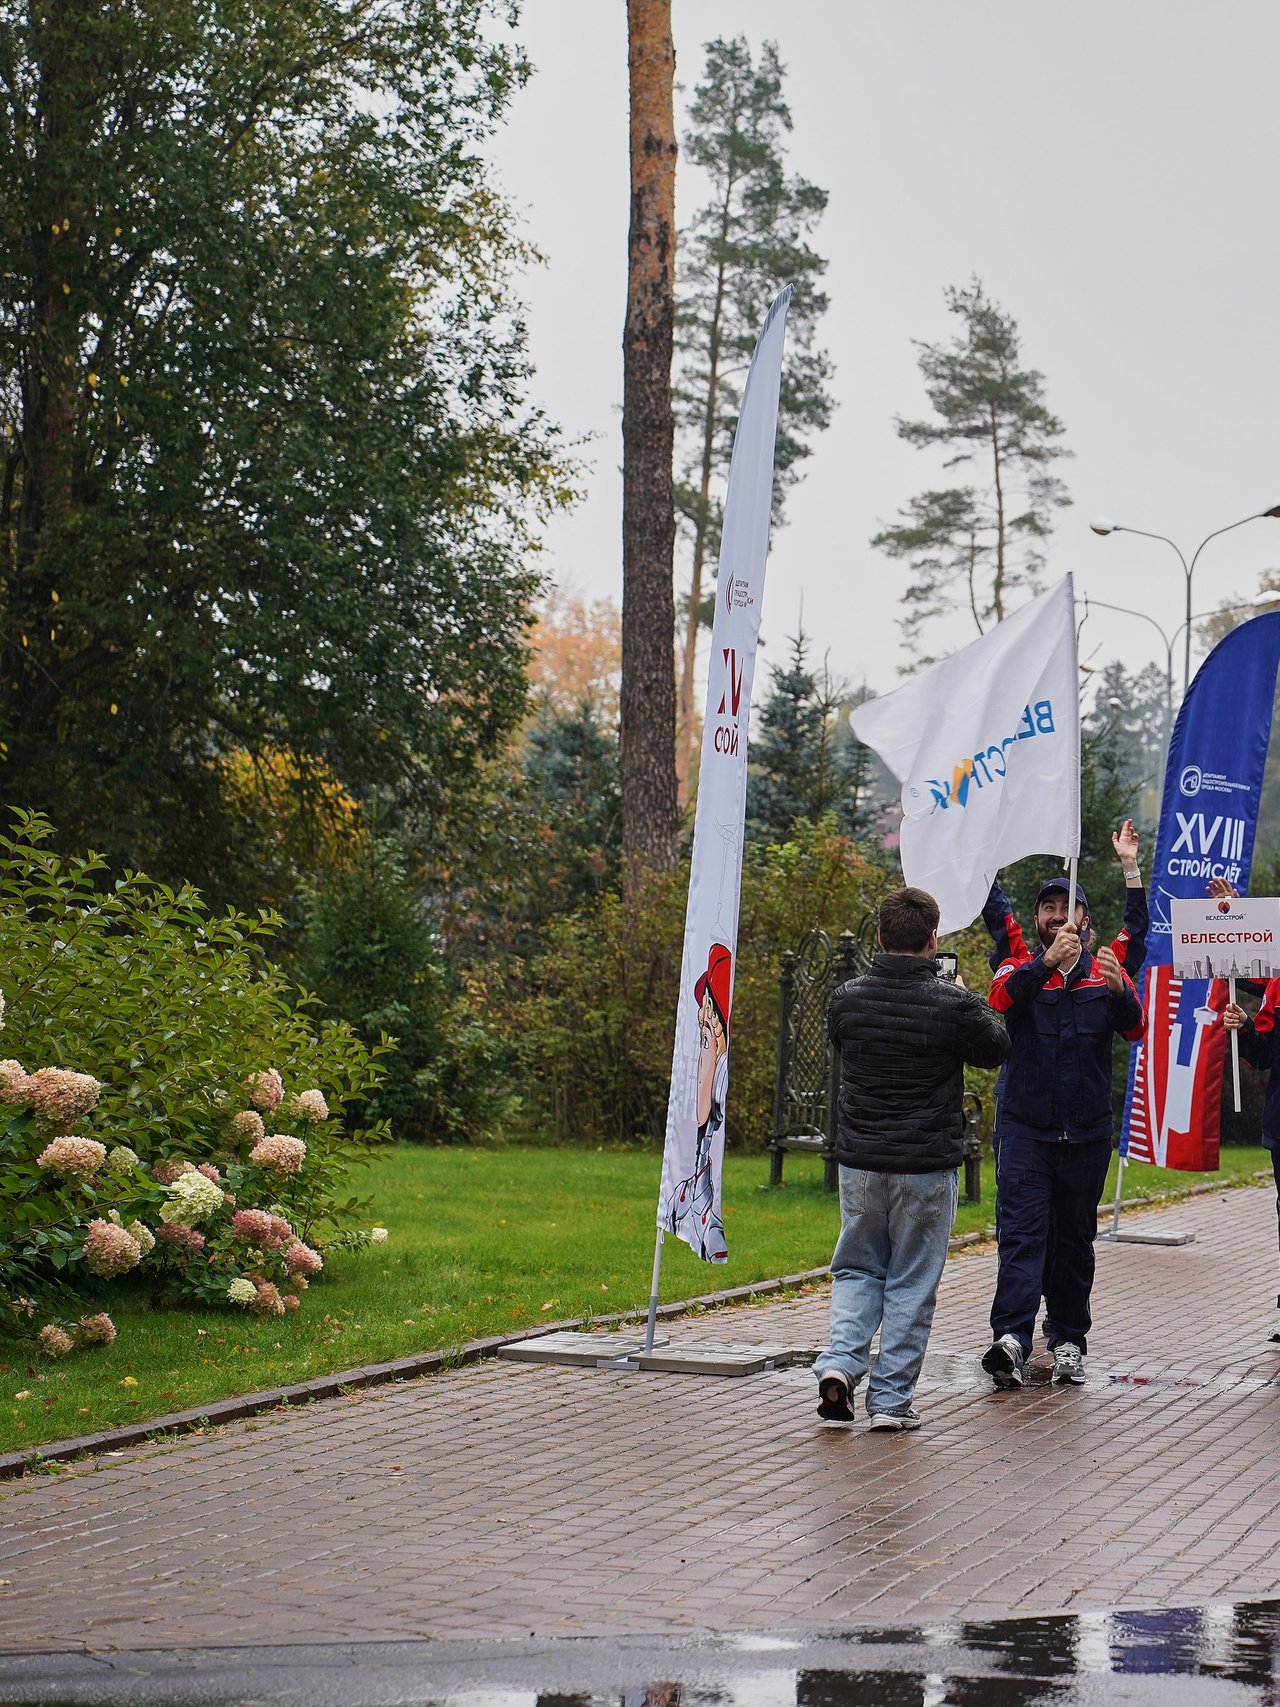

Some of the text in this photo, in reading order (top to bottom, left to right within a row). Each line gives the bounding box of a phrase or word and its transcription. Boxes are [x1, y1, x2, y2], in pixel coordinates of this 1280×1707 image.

[1170, 812, 1246, 861] XVIII
[1167, 856, 1242, 884] СТРОЙСЛЁТ
[1181, 928, 1273, 944] ВЕЛЕССТРОЙ
